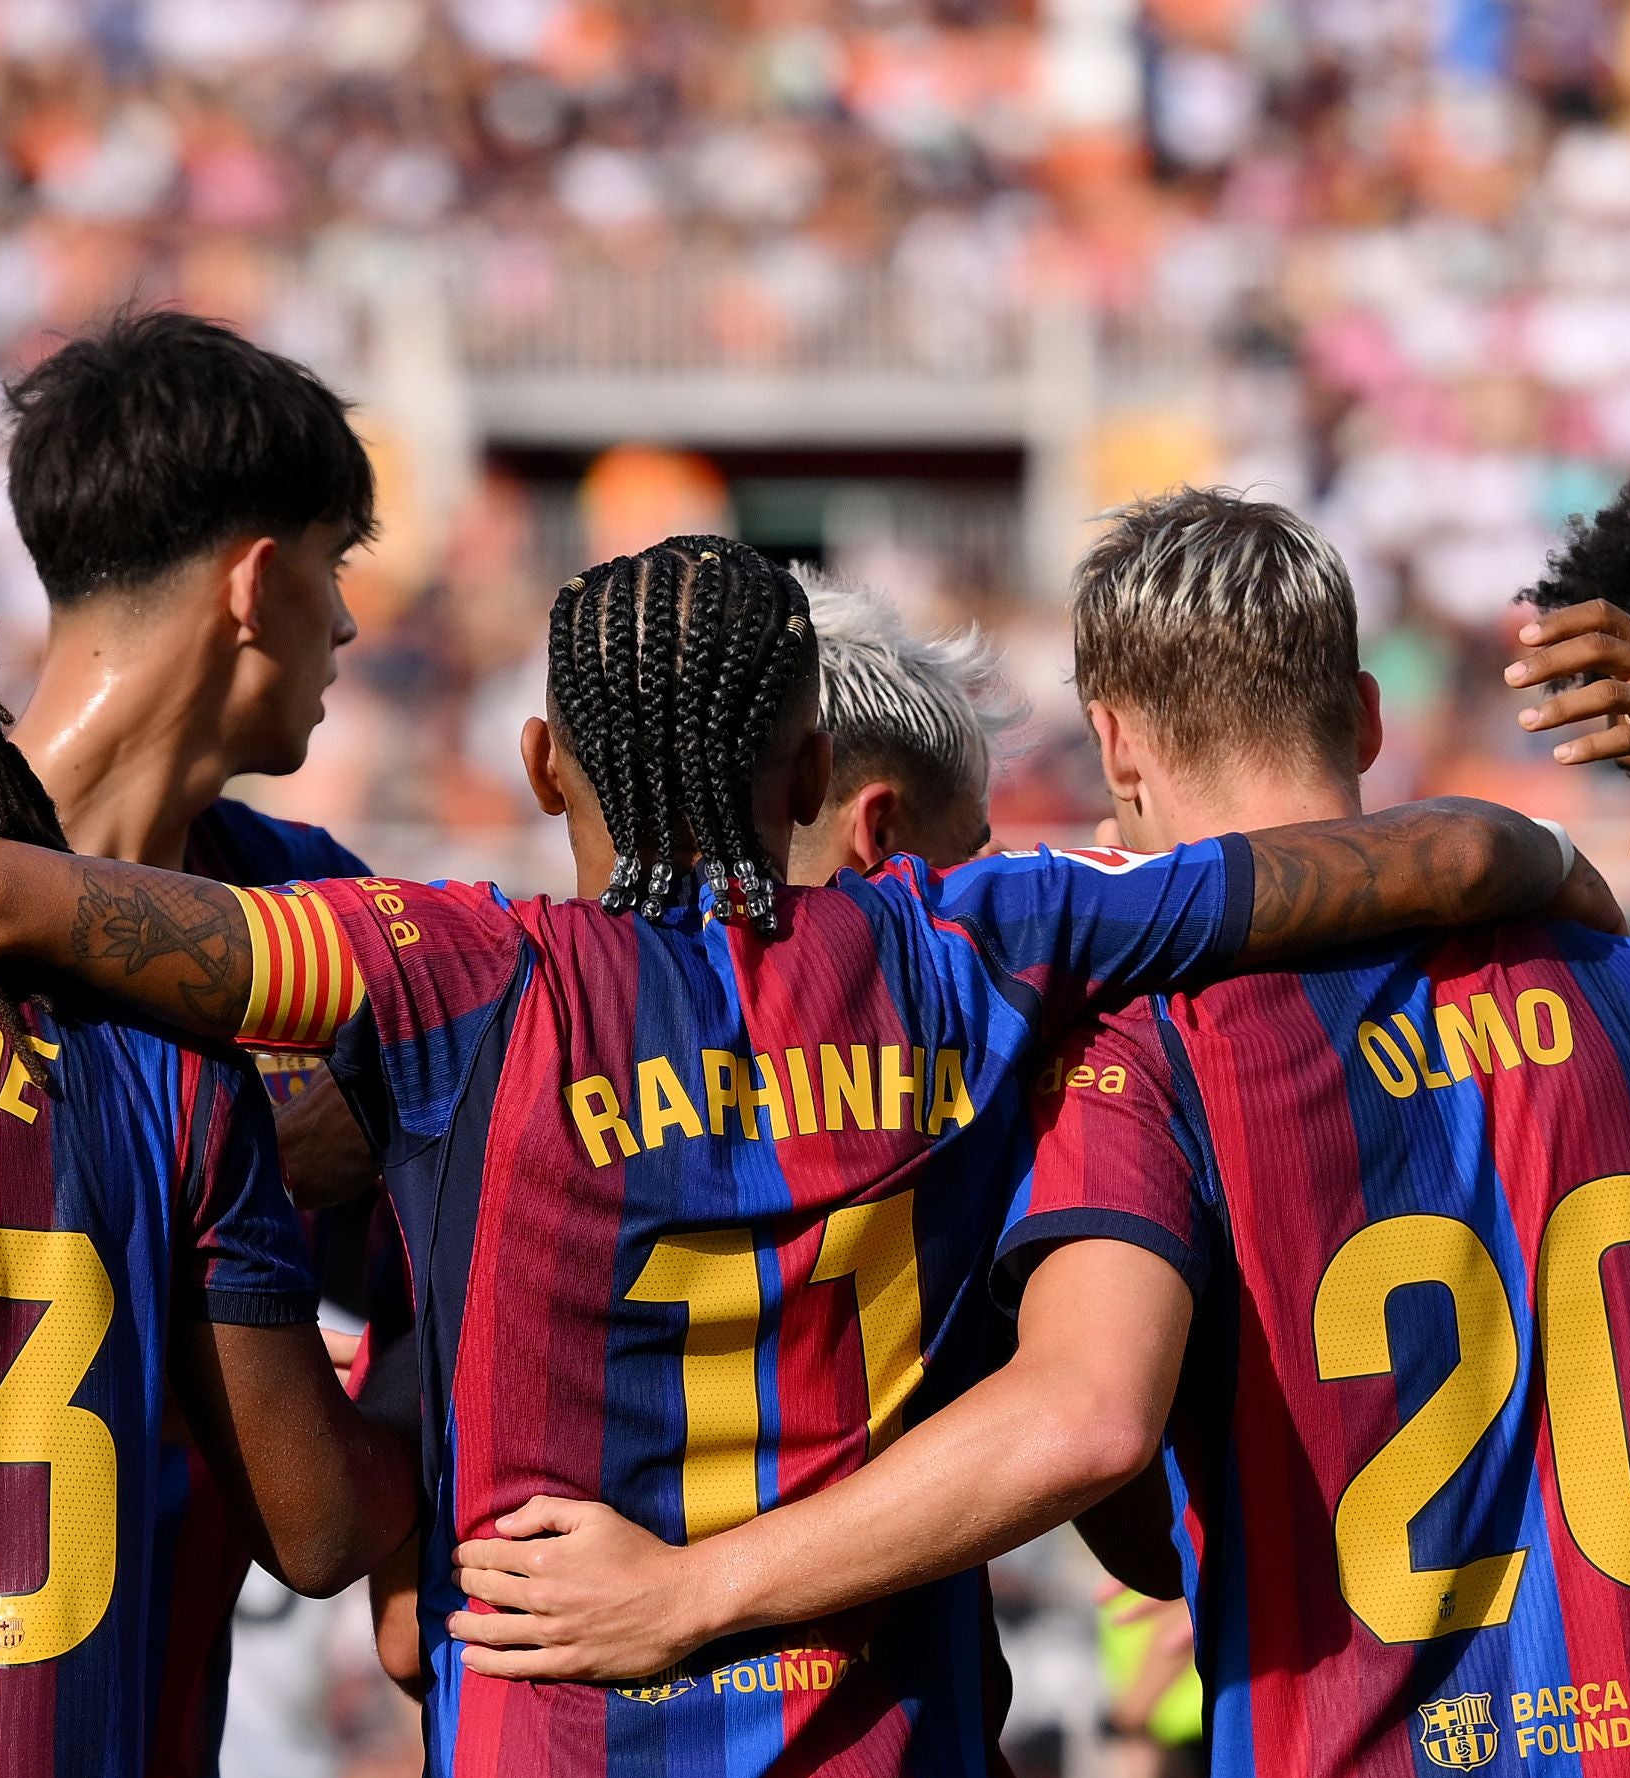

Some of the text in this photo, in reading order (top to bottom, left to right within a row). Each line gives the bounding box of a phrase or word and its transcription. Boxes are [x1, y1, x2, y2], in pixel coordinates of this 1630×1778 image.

[1358, 987, 1575, 1099] OLMO
[562, 1043, 976, 1169] RAPHINHA
[623, 1187, 926, 1547] 11
[1445, 1725, 1475, 1738] FCB
[1511, 1679, 1629, 1721] BARÇA
